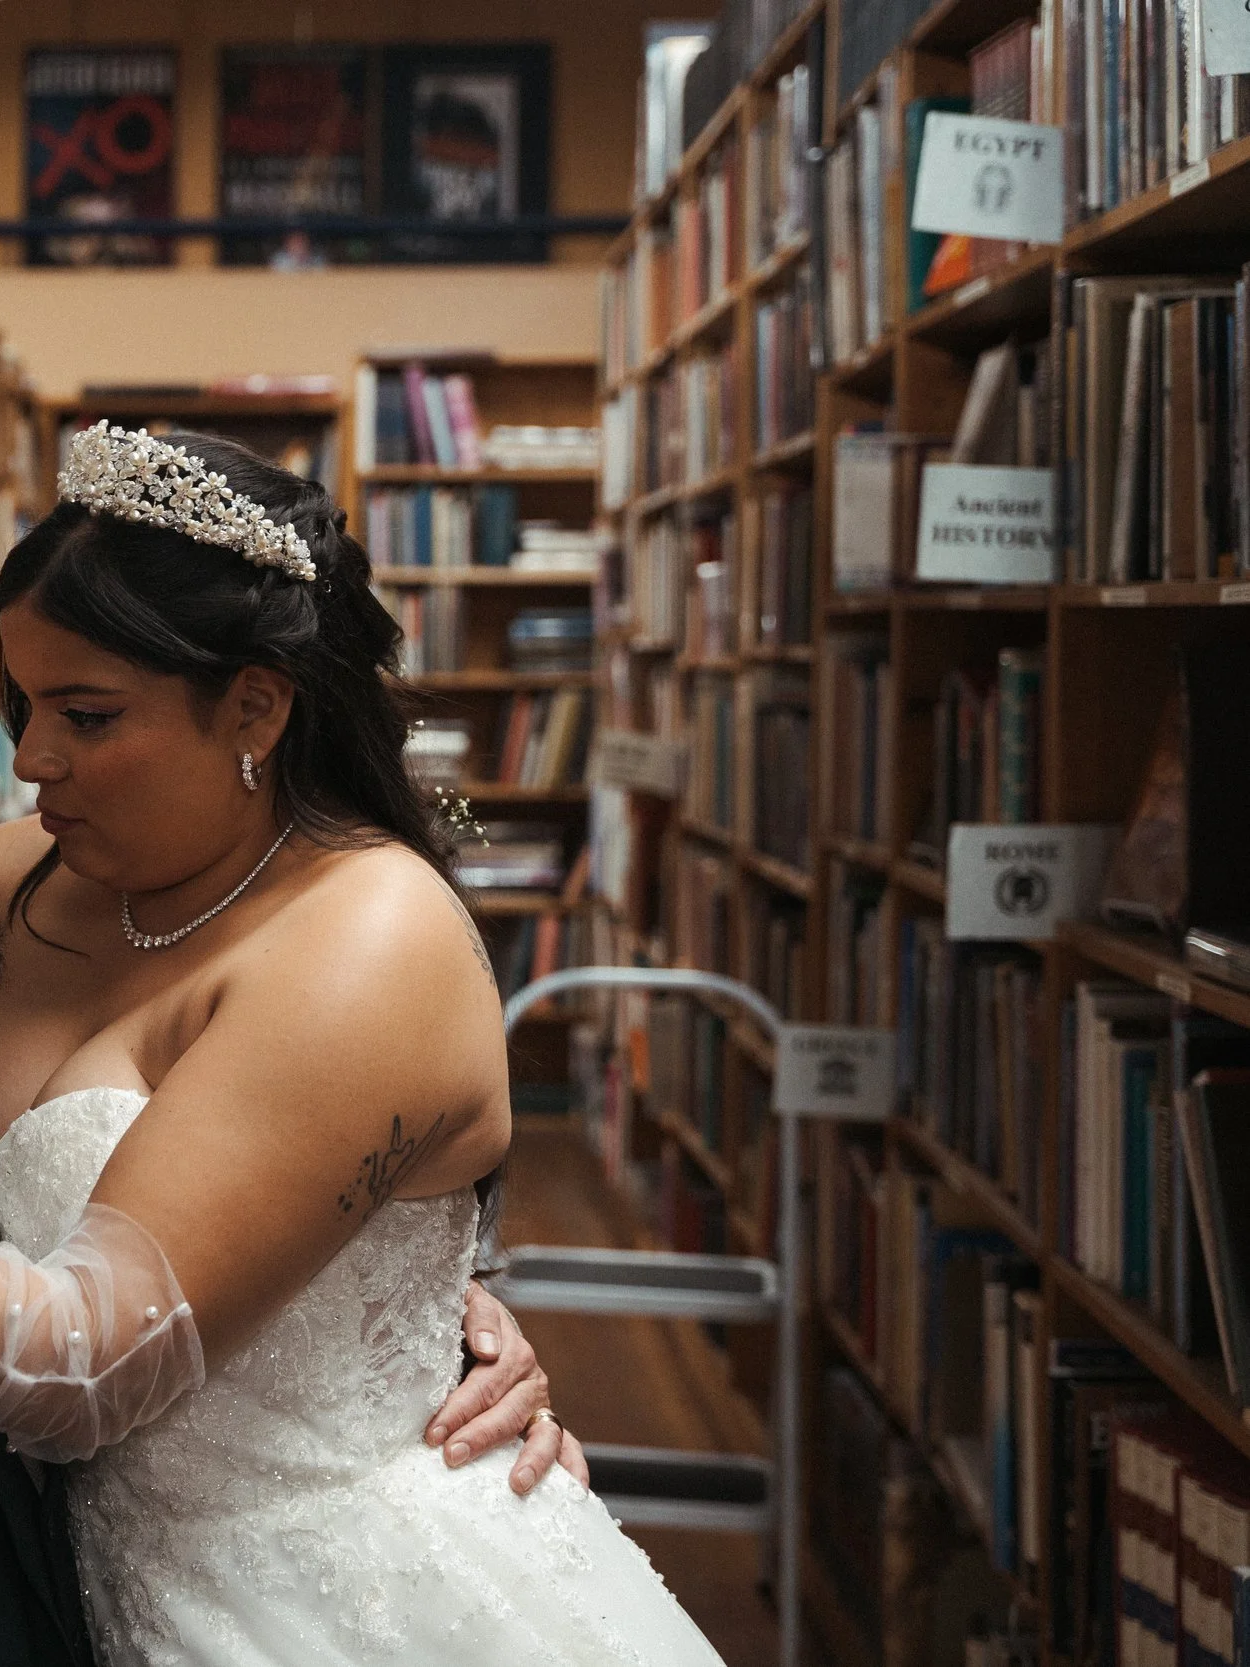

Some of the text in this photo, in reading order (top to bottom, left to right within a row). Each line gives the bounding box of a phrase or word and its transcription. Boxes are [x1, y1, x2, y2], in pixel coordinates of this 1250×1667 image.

[30, 91, 173, 196] XO
[954, 129, 1047, 161] EGYPT
[954, 493, 1043, 517] Ancient
[931, 522, 1053, 548] HISTORY
[984, 843, 1061, 862] ROME
